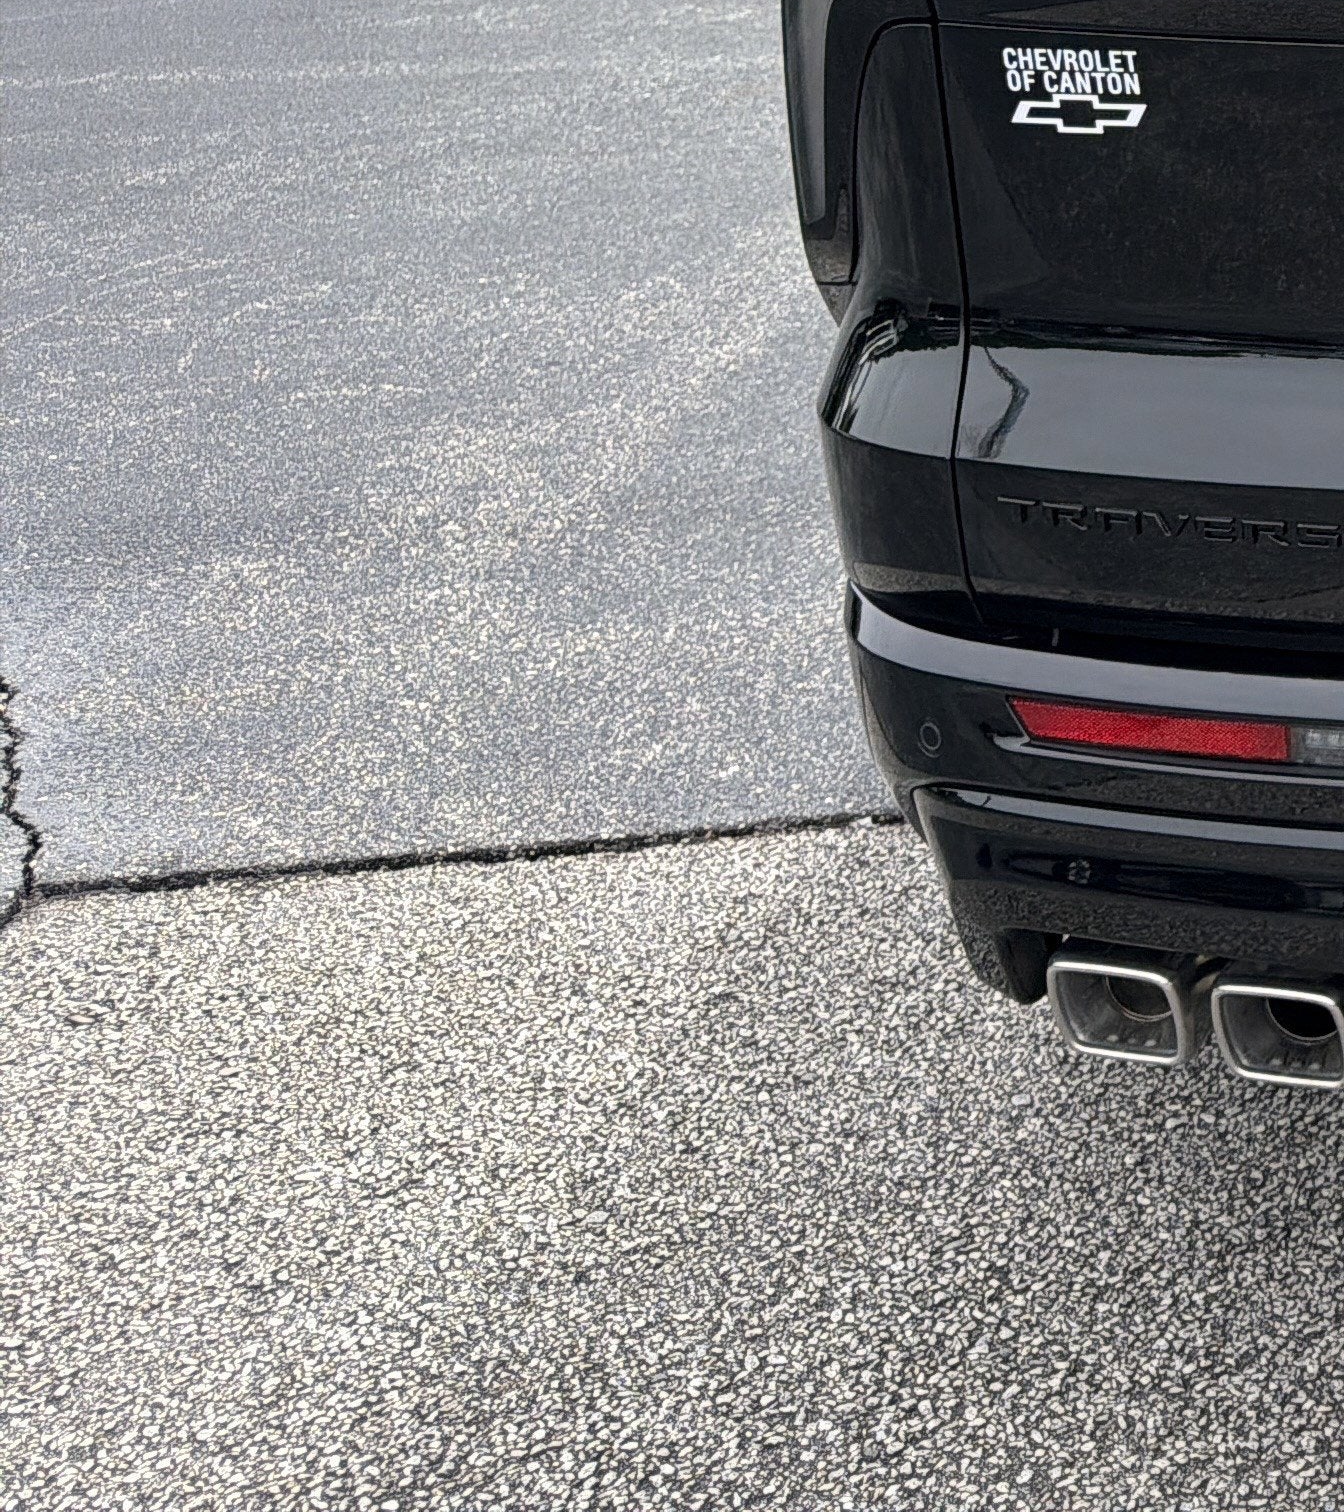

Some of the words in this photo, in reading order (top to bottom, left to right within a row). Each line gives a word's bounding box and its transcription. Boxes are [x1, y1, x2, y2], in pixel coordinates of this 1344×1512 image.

[1002, 47, 1138, 73] CHEVROLET
[1006, 70, 1036, 92] OF
[1043, 71, 1142, 95] CANTON
